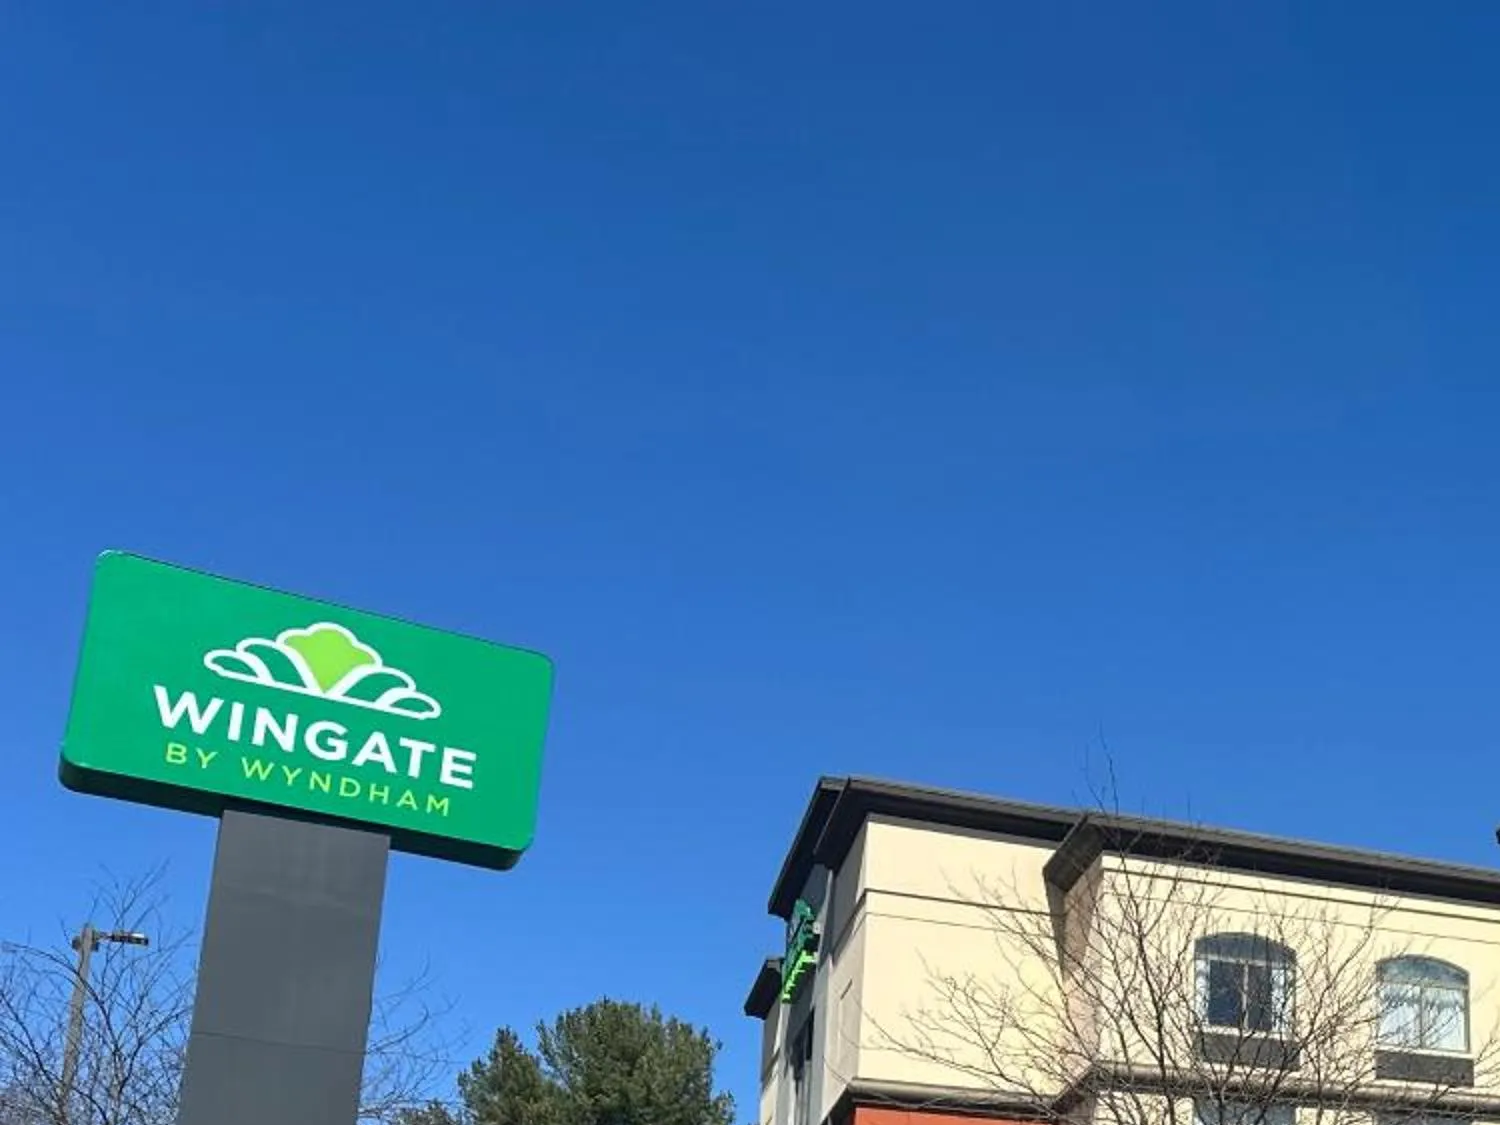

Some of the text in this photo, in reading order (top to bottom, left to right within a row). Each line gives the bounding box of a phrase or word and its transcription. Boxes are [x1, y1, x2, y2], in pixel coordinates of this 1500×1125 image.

[153, 684, 478, 789] WINGATE
[165, 743, 451, 817] BY WYNDHAM
